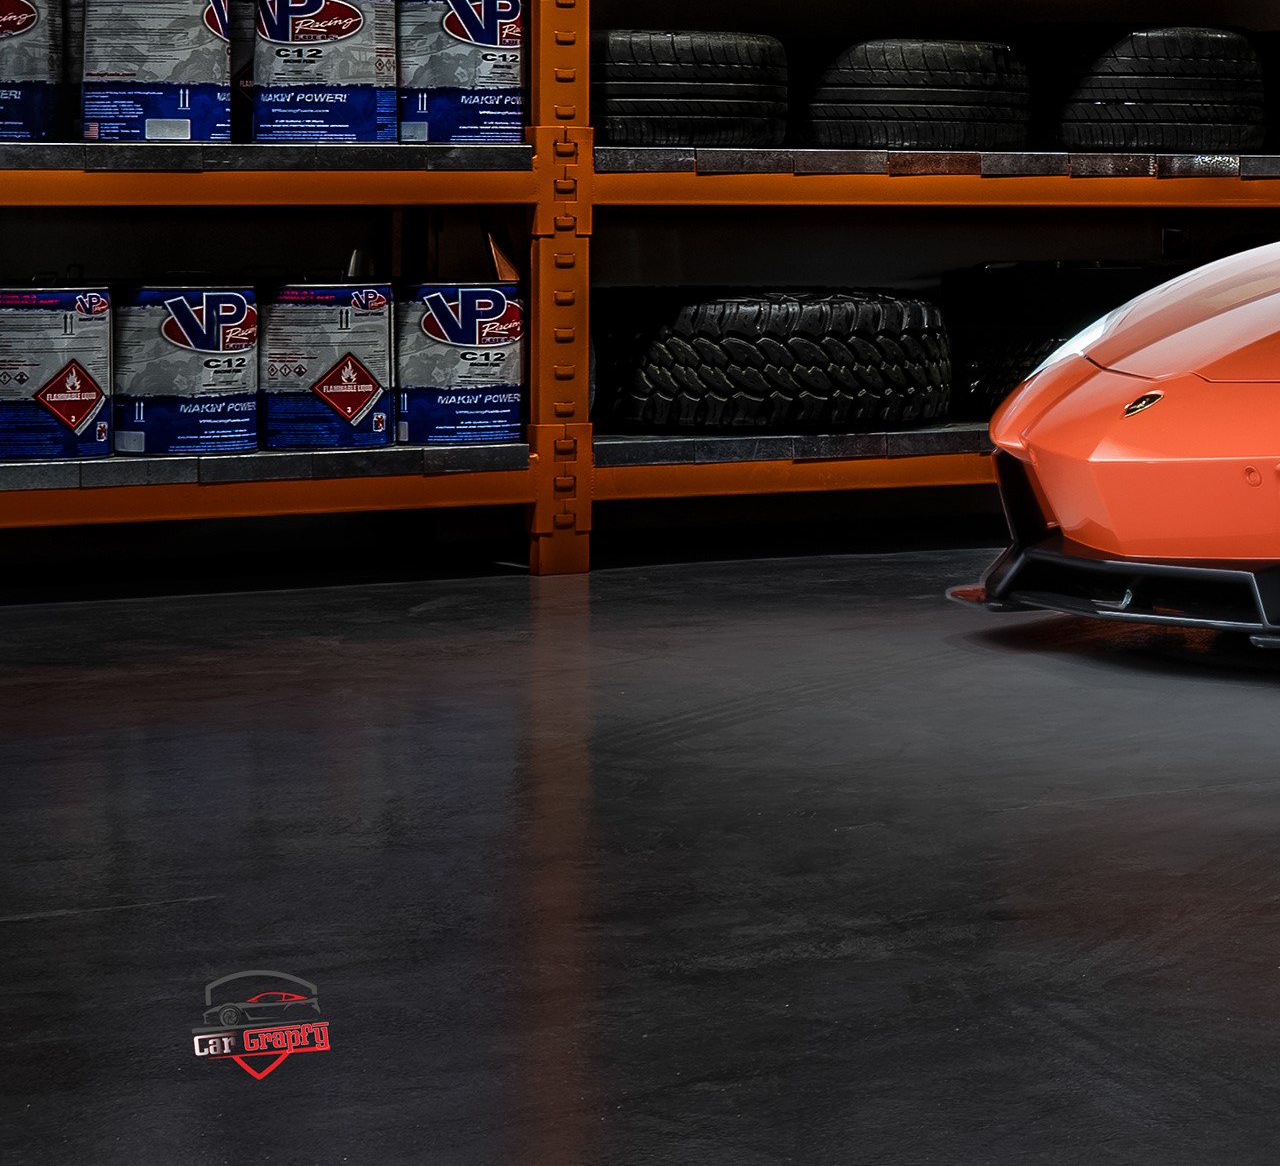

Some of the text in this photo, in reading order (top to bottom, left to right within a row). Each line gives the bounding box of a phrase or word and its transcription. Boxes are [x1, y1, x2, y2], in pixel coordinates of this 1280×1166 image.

[295, 17, 361, 33] Racing
[275, 48, 323, 58] C12
[481, 53, 519, 62] C12
[296, 93, 347, 102] POWER!
[76, 293, 101, 314] VP
[352, 289, 378, 310] VP
[164, 292, 247, 351] VP
[423, 288, 507, 344] VP
[203, 358, 246, 368] C12
[460, 351, 506, 362] C12
